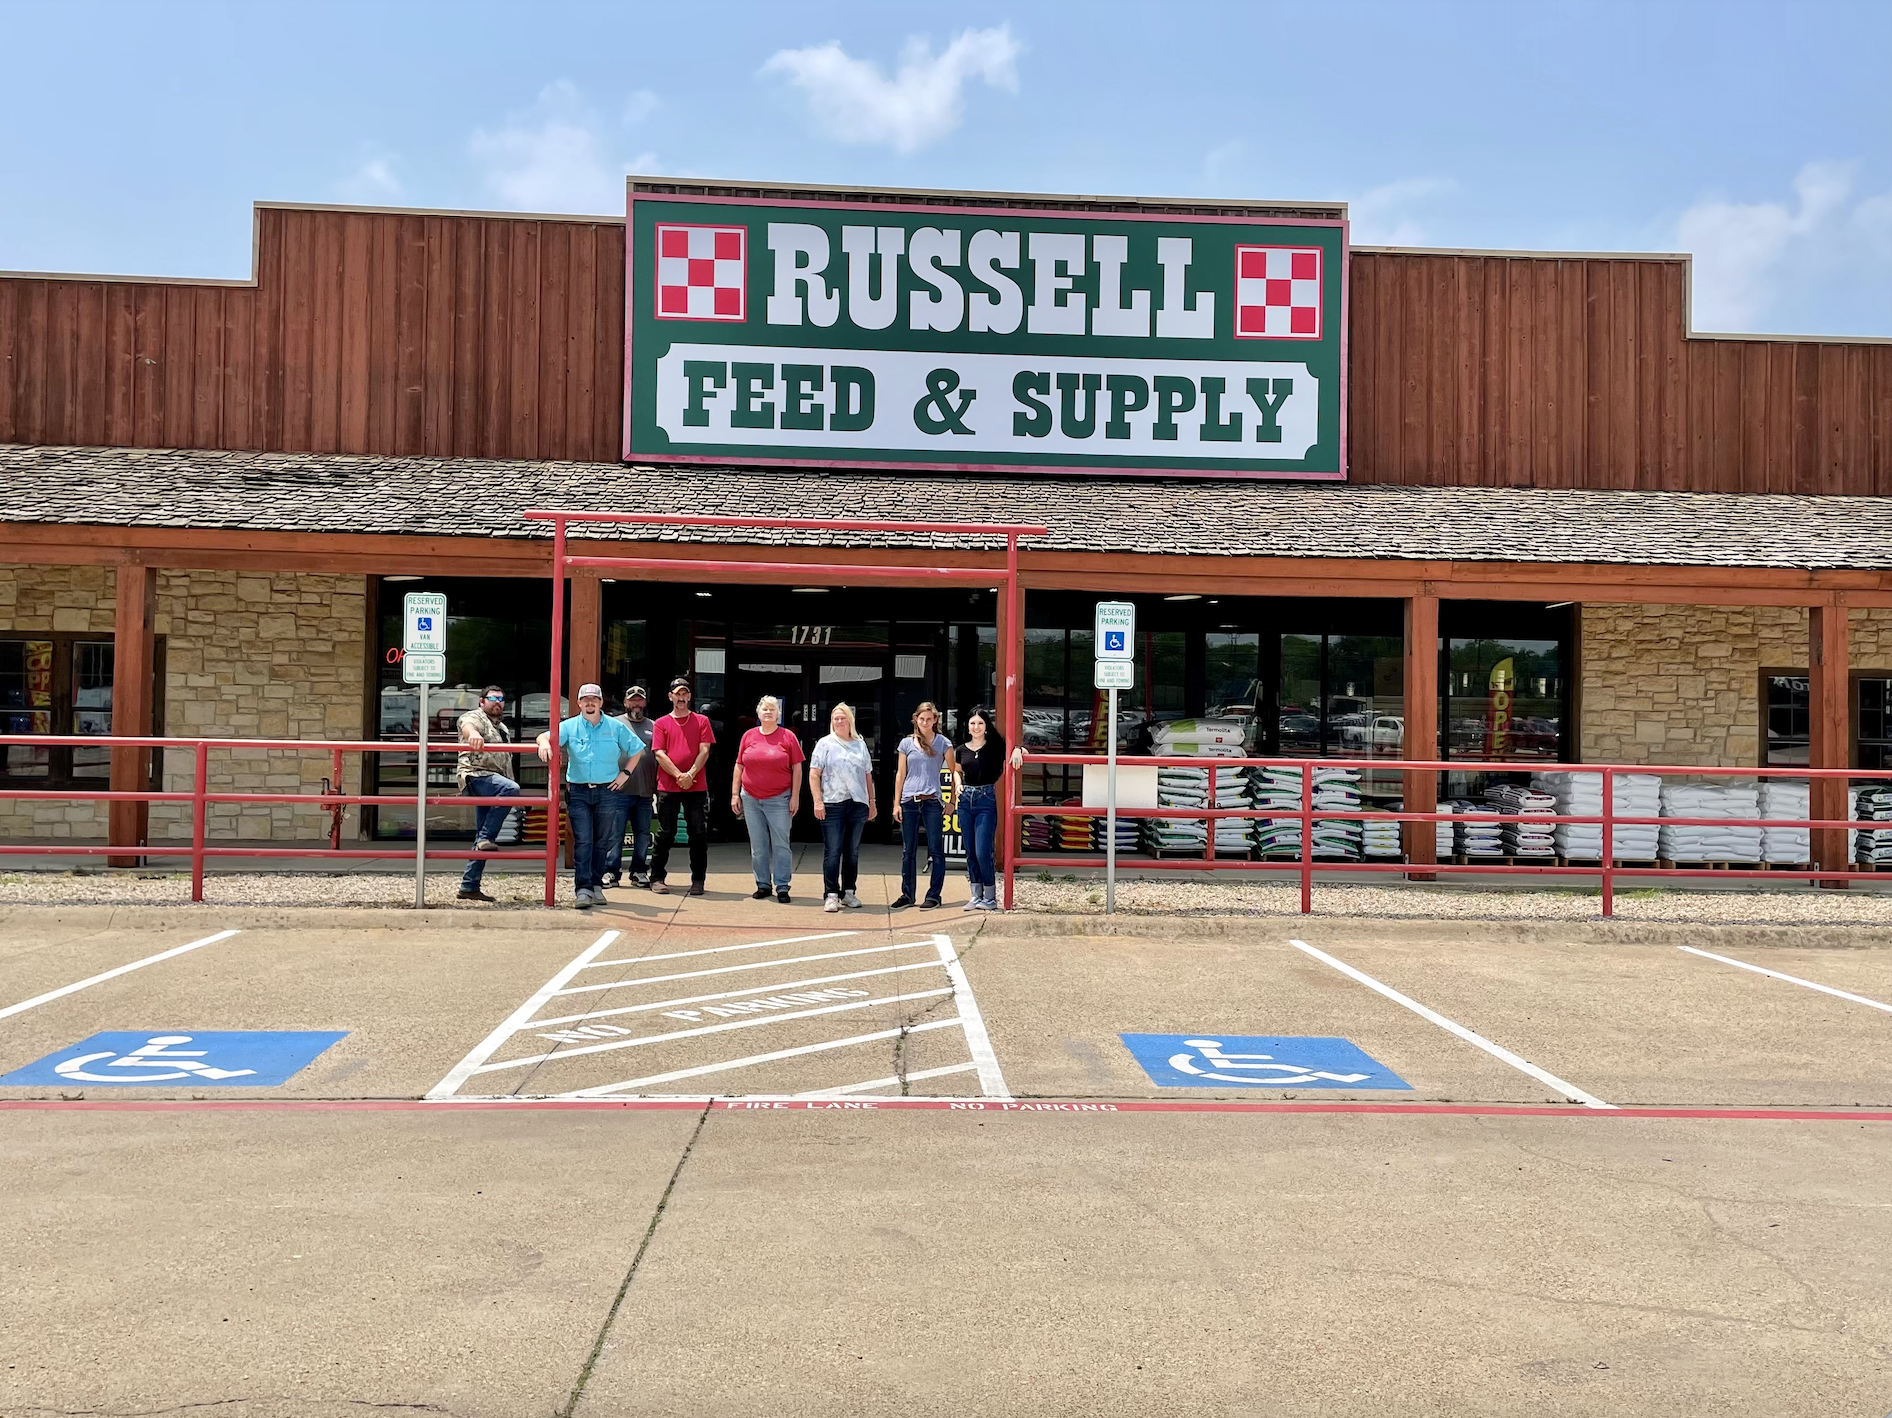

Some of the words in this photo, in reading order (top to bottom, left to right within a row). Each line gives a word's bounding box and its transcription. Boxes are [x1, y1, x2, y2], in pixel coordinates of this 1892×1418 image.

[766, 222, 1216, 339] RUSSELL
[682, 360, 876, 432] FEED
[913, 368, 977, 435] &
[1012, 371, 1294, 443] SUPPLY
[408, 597, 443, 605] RESERVED
[410, 607, 440, 615] PARKING
[1100, 608, 1132, 616] RESERVED
[1101, 618, 1130, 626] PARKING
[791, 626, 831, 645] 1731
[536, 1024, 631, 1043] NO
[661, 988, 870, 1022] PARKING
[727, 1101, 790, 1109] FIRE
[806, 1101, 879, 1109] LANE
[950, 1102, 985, 1110] NO
[1002, 1102, 1119, 1111] PARKING
